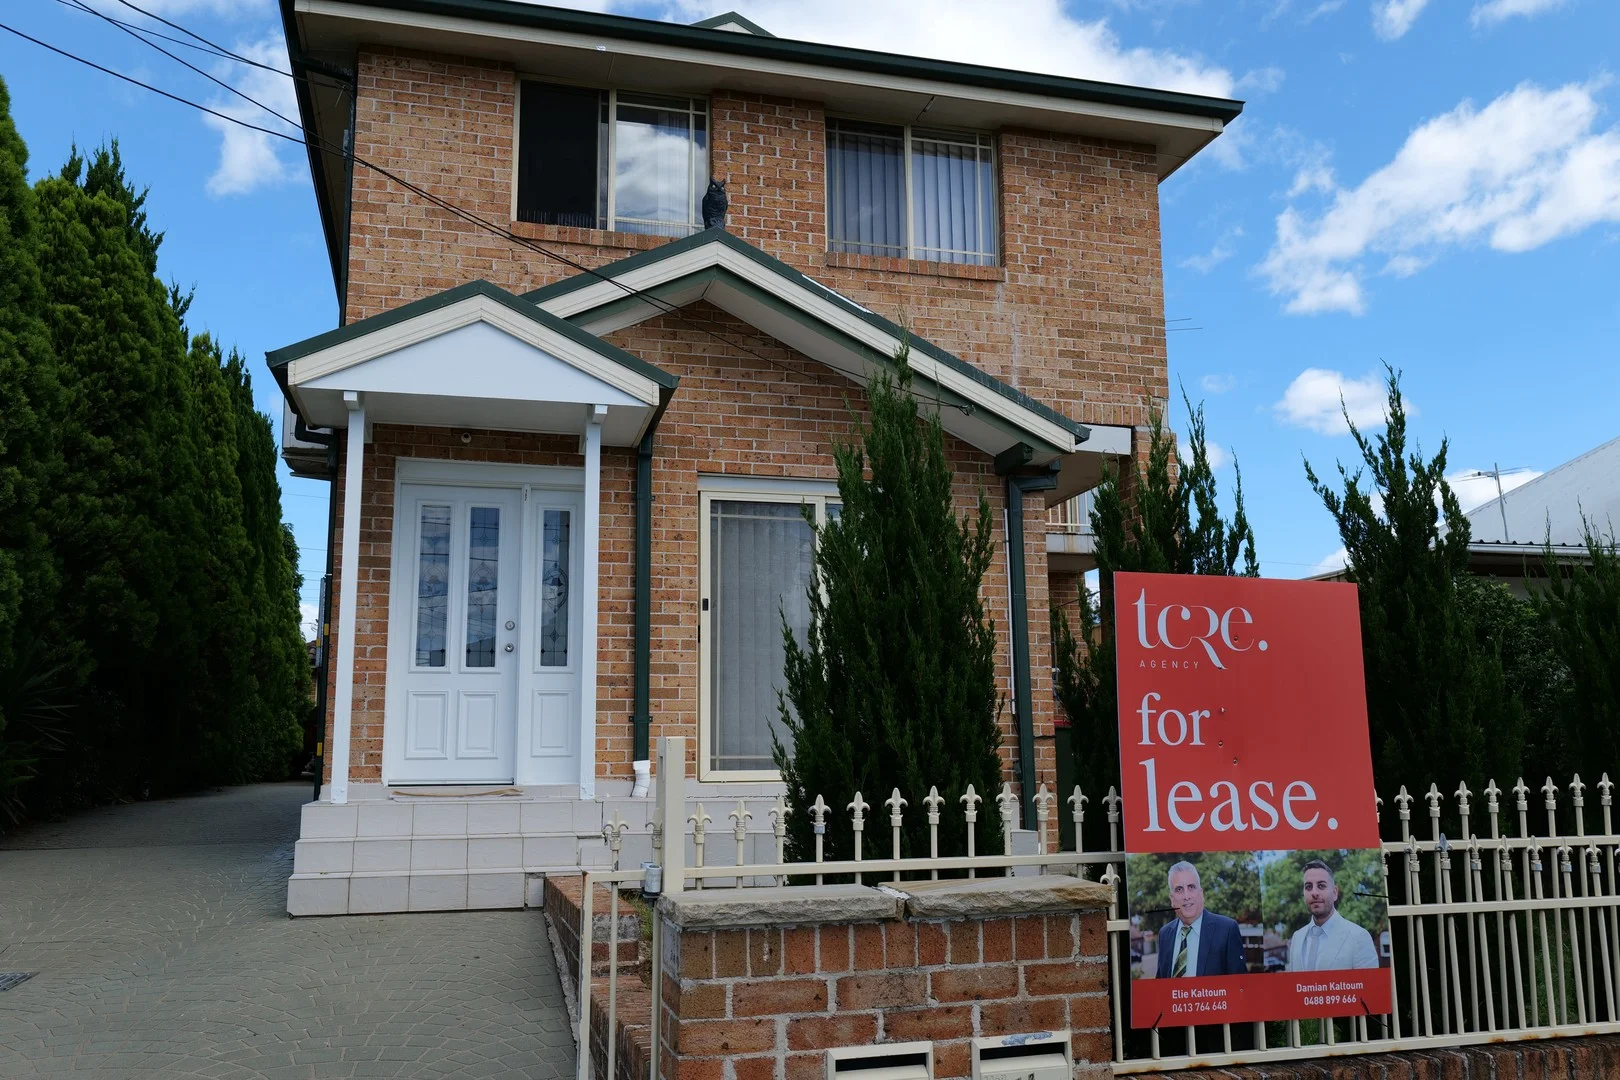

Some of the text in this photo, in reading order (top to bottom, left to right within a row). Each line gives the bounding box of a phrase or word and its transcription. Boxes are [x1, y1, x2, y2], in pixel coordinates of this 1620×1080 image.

[1139, 660, 1200, 669] AGENCY
[1136, 692, 1211, 746] for
[1138, 758, 1339, 832] lease.
[1296, 981, 1364, 993] Damian Kaltoum
[1172, 988, 1227, 999] Elie Kaltoum
[1303, 994, 1357, 1006] 0488 899 666
[1172, 1000, 1228, 1013] 0413 764 648
